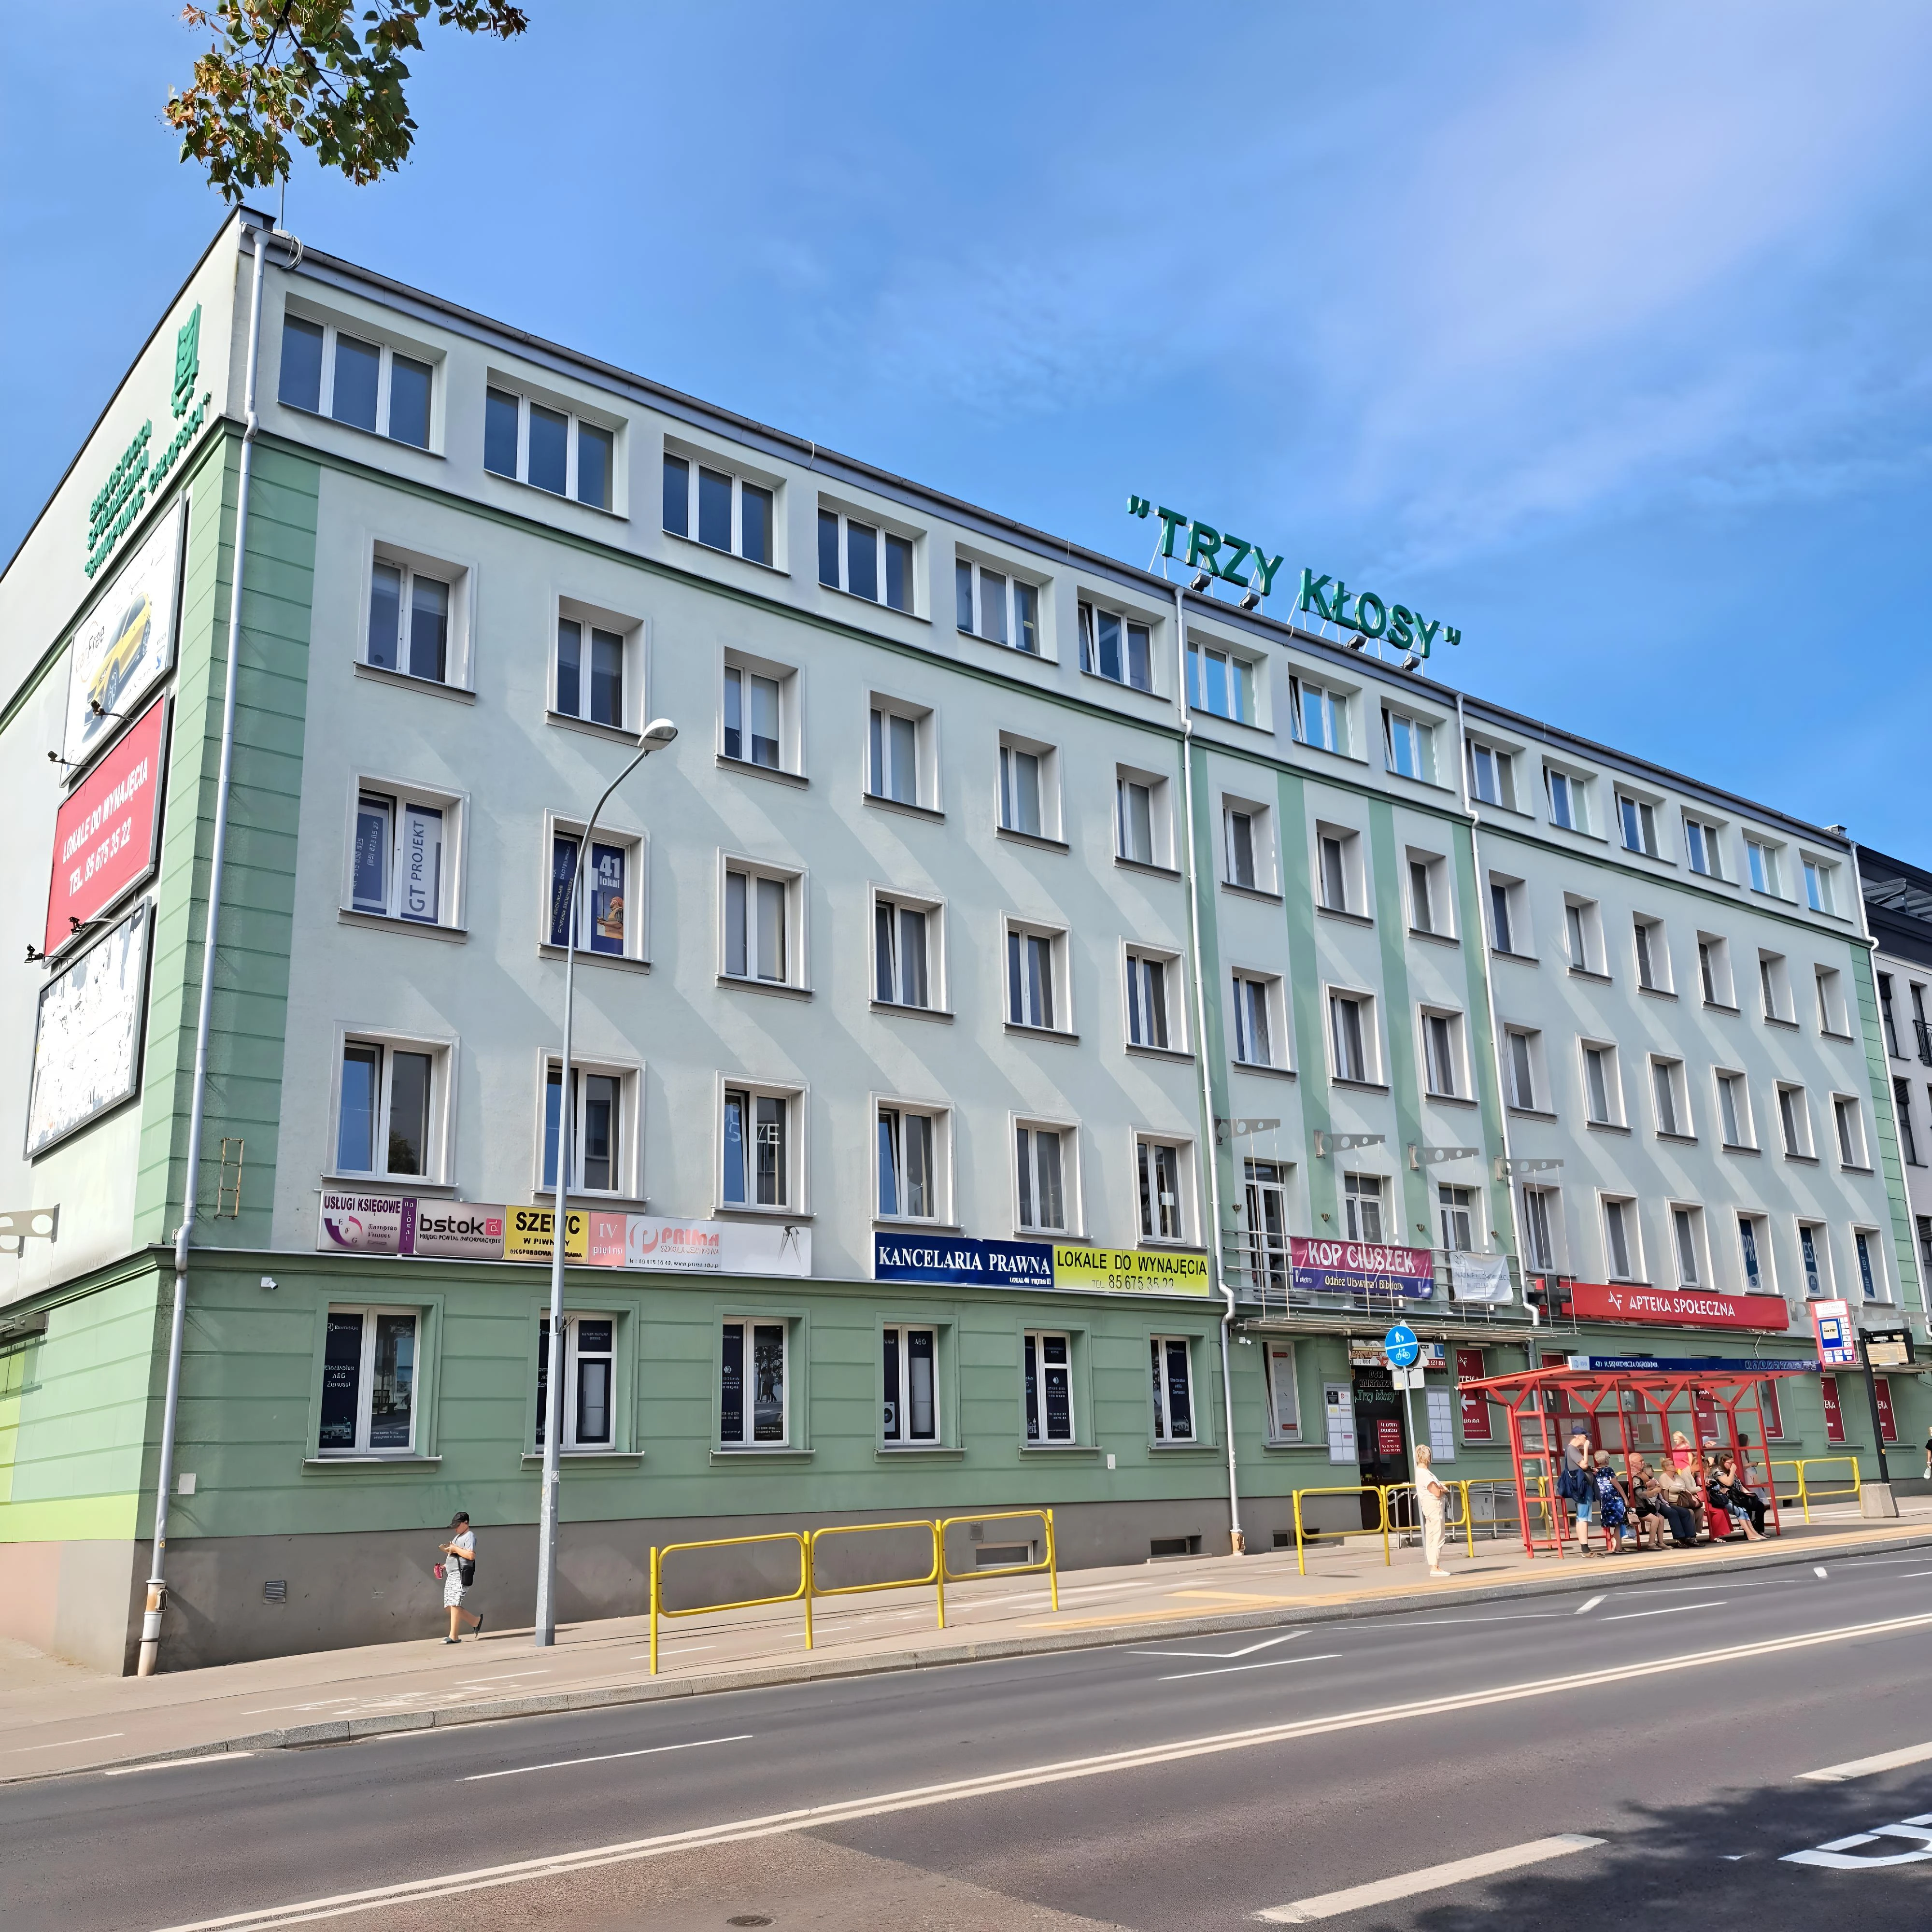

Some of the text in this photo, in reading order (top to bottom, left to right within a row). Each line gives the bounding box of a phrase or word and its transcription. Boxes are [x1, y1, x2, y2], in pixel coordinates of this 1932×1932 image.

[409, 820, 426, 912] GT PROJEKT
[599, 854, 620, 879] 41
[324, 1195, 401, 1216] USŁUGI KSIĘGOWE
[420, 1213, 484, 1235] bstok
[598, 1223, 618, 1238] IV
[533, 1238, 570, 1247] PIWNY
[1308, 1241, 1343, 1266] KOP
[879, 1246, 1051, 1275] KANCELARIA PRAWNA
[1057, 1250, 1208, 1278] LOKALE DO WYNAJĘCIA
[1108, 1274, 1122, 1289] 85
[1124, 1275, 1144, 1291] 675
[1147, 1276, 1159, 1292] 35
[1162, 1277, 1174, 1293] 22
[1629, 1295, 1735, 1317] APTEKA SPOŁECZNA
